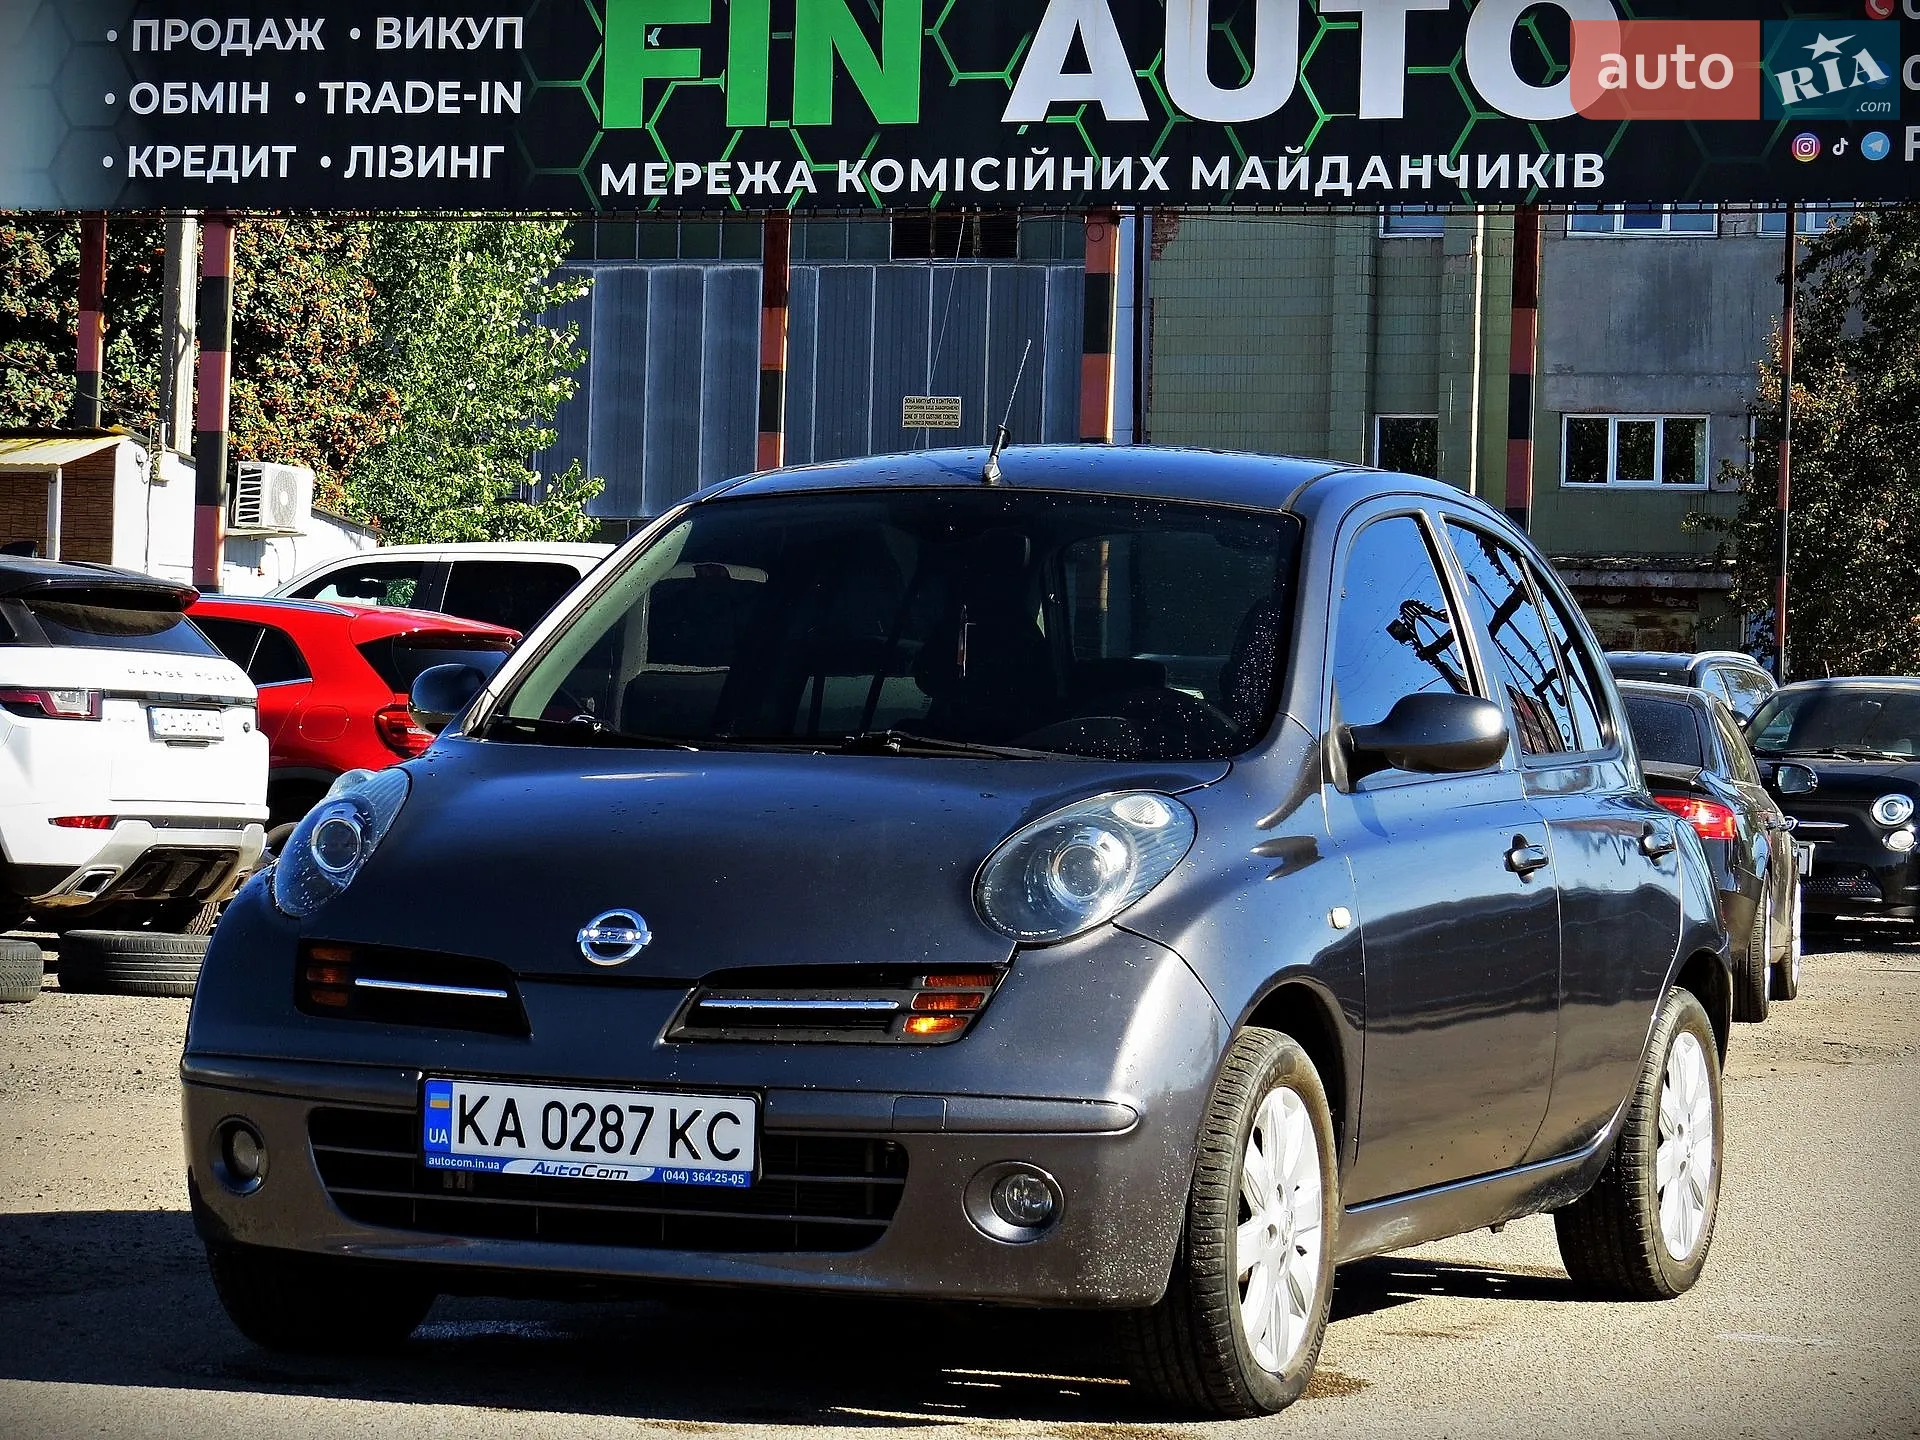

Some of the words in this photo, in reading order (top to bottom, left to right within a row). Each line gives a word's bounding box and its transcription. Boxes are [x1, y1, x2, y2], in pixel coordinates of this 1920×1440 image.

[132, 18, 325, 56] ПРОДАЖ
[375, 17, 524, 50] ВИКУП
[602, 0, 924, 129] FIN
[1001, 0, 1621, 122] AUTO
[129, 82, 269, 114] ОБМІН
[319, 81, 522, 114] TRADE-IN
[128, 145, 297, 183] КРЕДИТ
[344, 145, 504, 179] ЛІЗИНГ
[601, 161, 817, 195] МЕРЕЖА
[837, 148, 1169, 194] КОМІСІЙНИХ
[1191, 146, 1606, 197] МАЙДАНЧИКІВ
[429, 1127, 448, 1144] UA
[458, 1094, 526, 1149] KA
[541, 1100, 655, 1156] 0287
[668, 1108, 742, 1162] KC
[428, 1156, 500, 1170] autocom.in.ua
[530, 1161, 629, 1180] AutoCom
[662, 1171, 689, 1183] (044)
[692, 1172, 745, 1184] 364-25-05
